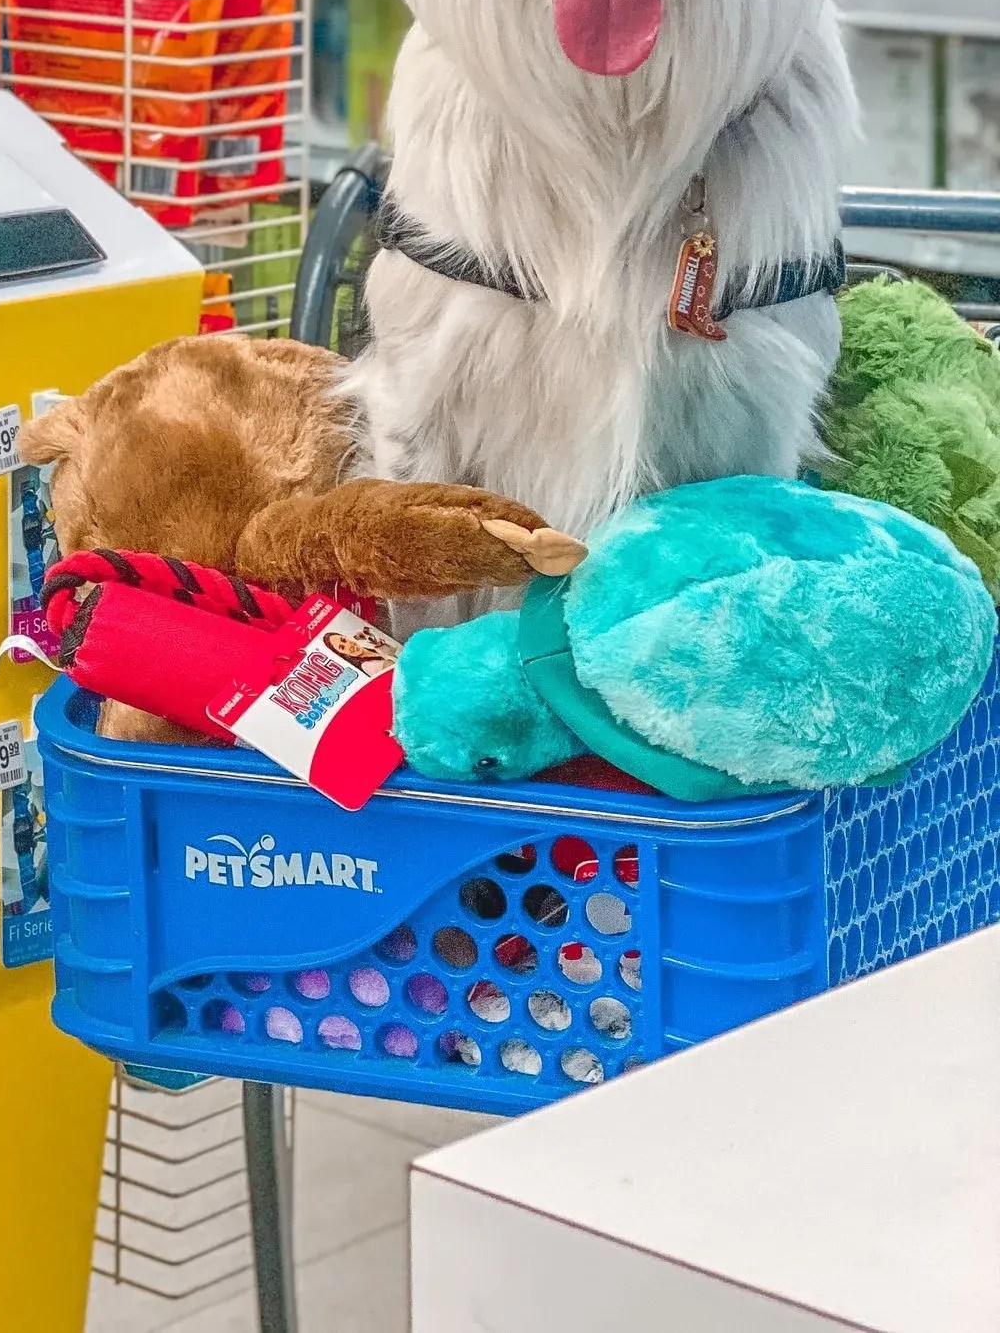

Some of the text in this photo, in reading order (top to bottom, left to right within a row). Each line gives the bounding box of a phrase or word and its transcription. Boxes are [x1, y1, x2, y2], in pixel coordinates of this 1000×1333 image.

[678, 256, 701, 313] PHARRELL
[269, 652, 345, 717] KONG
[185, 845, 378, 892] PETSMART
